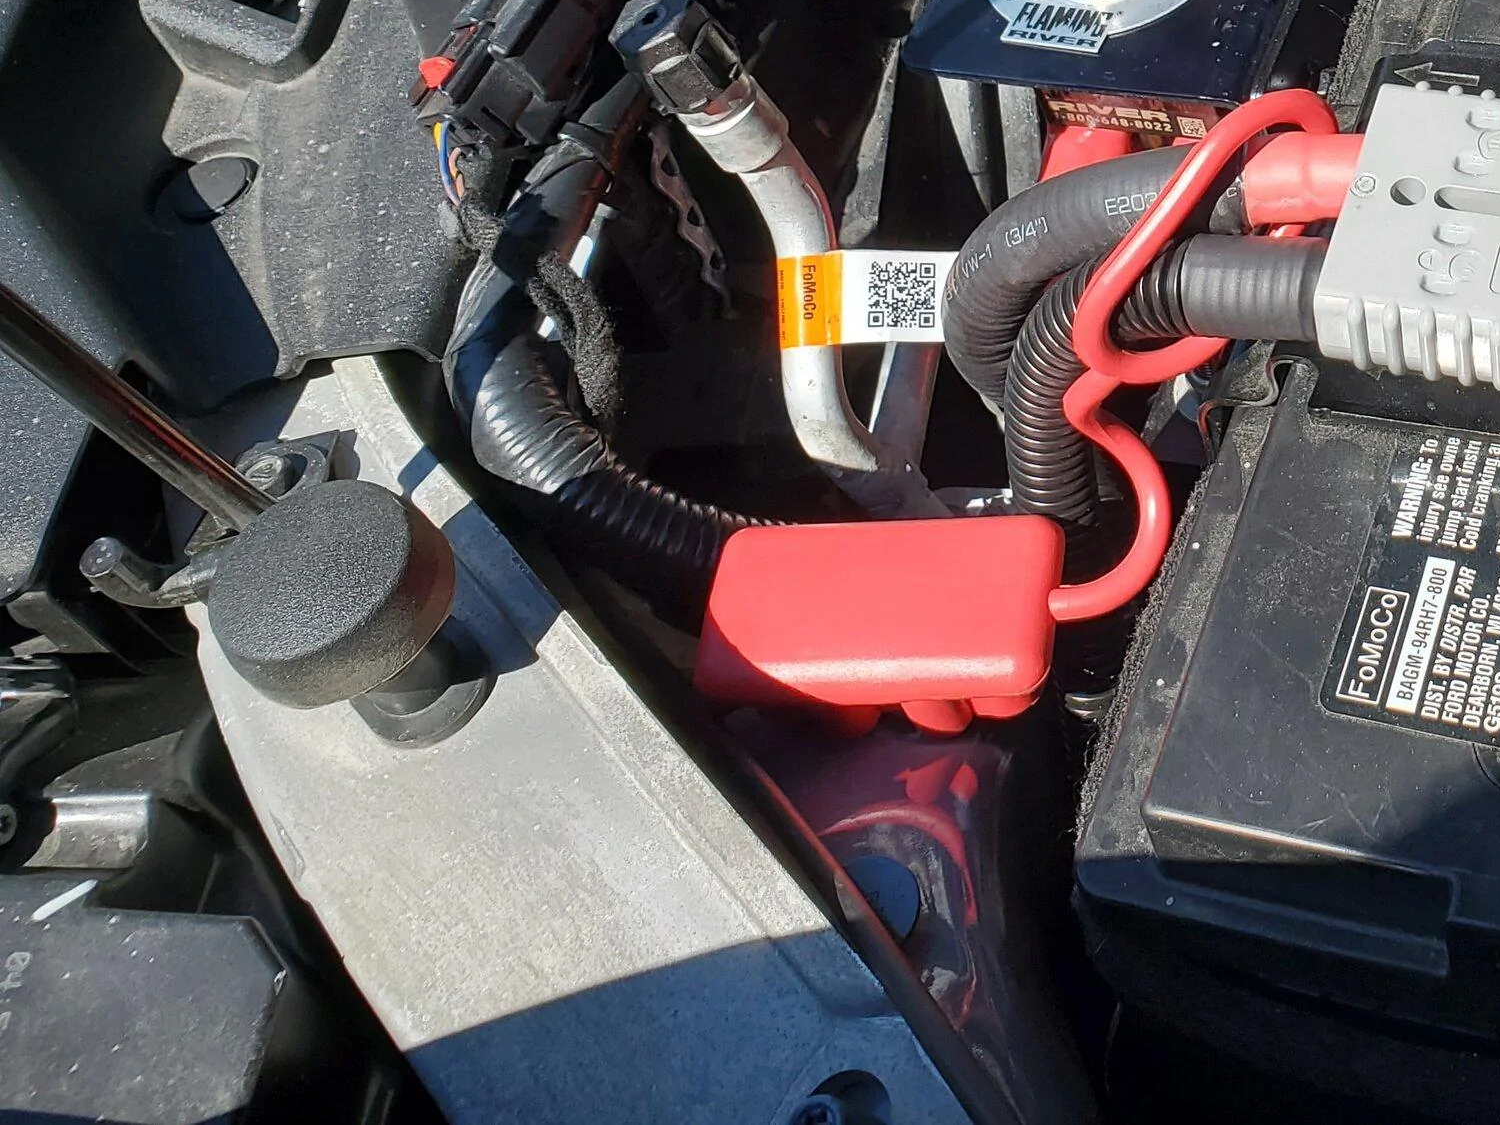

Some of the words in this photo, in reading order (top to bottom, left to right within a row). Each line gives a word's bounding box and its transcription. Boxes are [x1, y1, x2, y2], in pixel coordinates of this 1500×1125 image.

[1008, 29, 1098, 48] RIVER
[1012, 1, 1114, 37] FLAMING
[1049, 100, 1170, 123] RIVER
[802, 264, 817, 321] FoMoCo
[1391, 457, 1434, 538] WARNING:
[1420, 439, 1438, 453] To
[1451, 475, 1471, 509] start
[1416, 500, 1447, 543] injury
[1433, 475, 1448, 500] see
[1438, 508, 1465, 548] jump
[1459, 518, 1481, 549] Cold
[1453, 565, 1477, 599] PAR
[1468, 593, 1491, 619] CO.
[1347, 593, 1398, 698] FoMoCo
[1396, 566, 1448, 701] BAGM-94RH7-800
[1438, 602, 1468, 652] DISTR.
[1431, 652, 1453, 676] BY
[1452, 620, 1484, 678] MOTOR
[1419, 679, 1447, 719] DIST.
[1440, 679, 1468, 723] FORD
